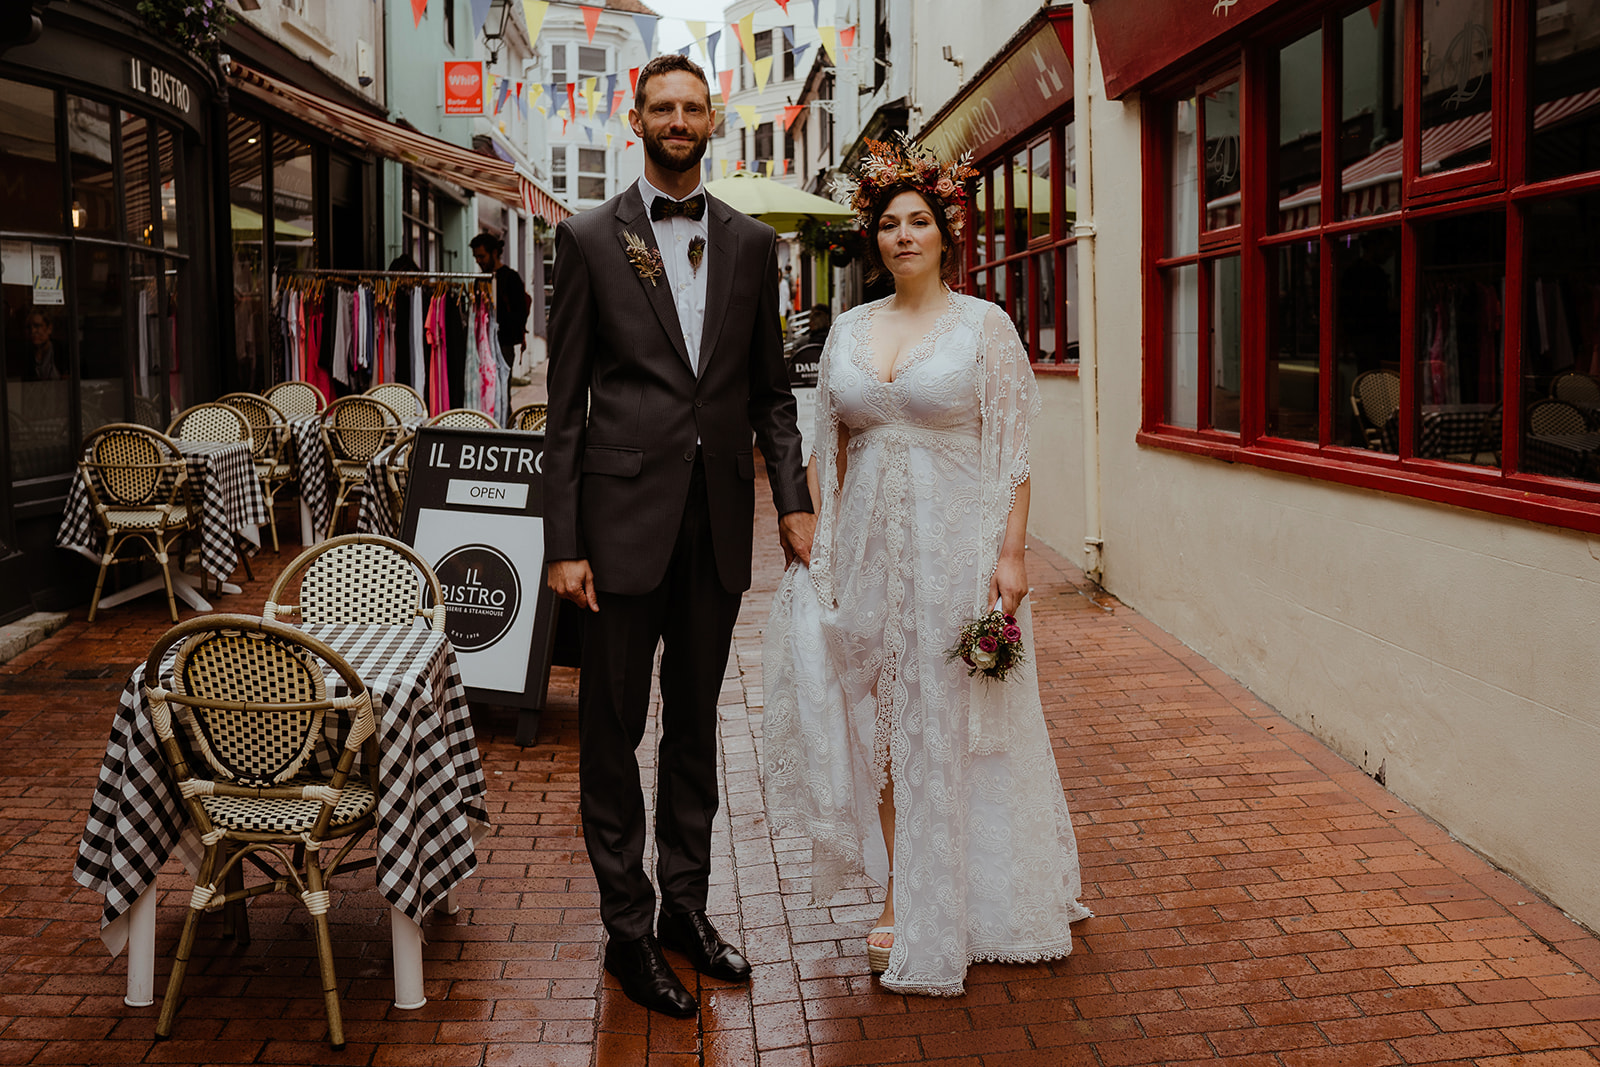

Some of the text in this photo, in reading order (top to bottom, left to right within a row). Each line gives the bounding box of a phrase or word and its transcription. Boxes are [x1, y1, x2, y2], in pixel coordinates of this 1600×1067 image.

[131, 57, 190, 113] IL BISTRO
[935, 97, 1001, 164] ONCARO
[795, 362, 820, 374] DAR
[429, 442, 451, 468] IL
[470, 486, 506, 499] OPEN
[466, 568, 482, 585] IL
[440, 584, 506, 606] BISTRO
[469, 608, 504, 617] STEAKHOUSE
